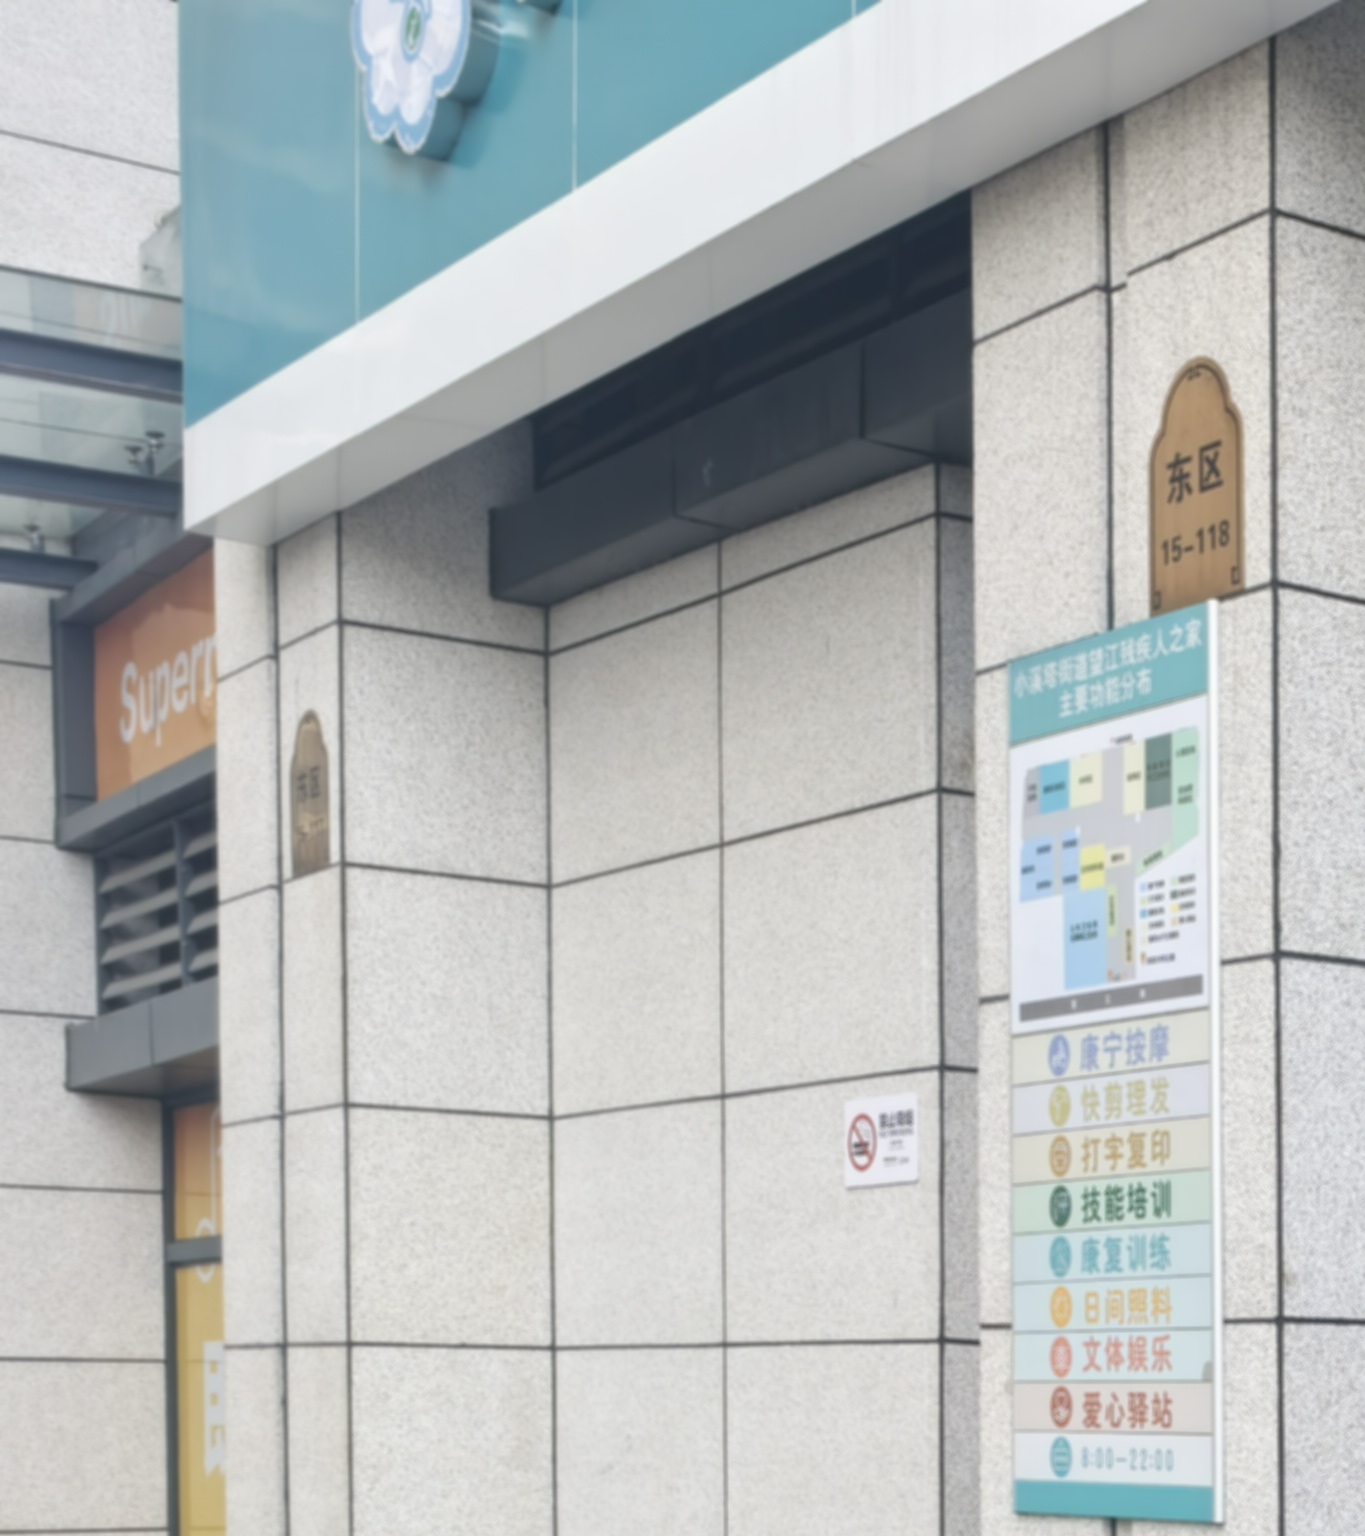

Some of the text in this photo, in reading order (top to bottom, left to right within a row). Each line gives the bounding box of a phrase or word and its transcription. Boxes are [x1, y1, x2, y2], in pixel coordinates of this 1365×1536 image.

[1166, 440, 1224, 504] 东区
[1161, 519, 1231, 565] 15-118
[1014, 618, 1203, 698] 小溪塔街道望江残疾人之家
[1058, 668, 1154, 718] 主要功能分布
[1080, 1024, 1170, 1072] 康宁按摩
[1081, 1076, 1170, 1122] 快剪理发
[1081, 1129, 1172, 1173] 打字复印
[1081, 1180, 1172, 1224] 技能培训
[1081, 1232, 1172, 1275] 康复训练
[1083, 1286, 1173, 1325] 日间照料
[1082, 1335, 1173, 1373] 文体娱乐
[1082, 1391, 1173, 1429] 爱心驿站
